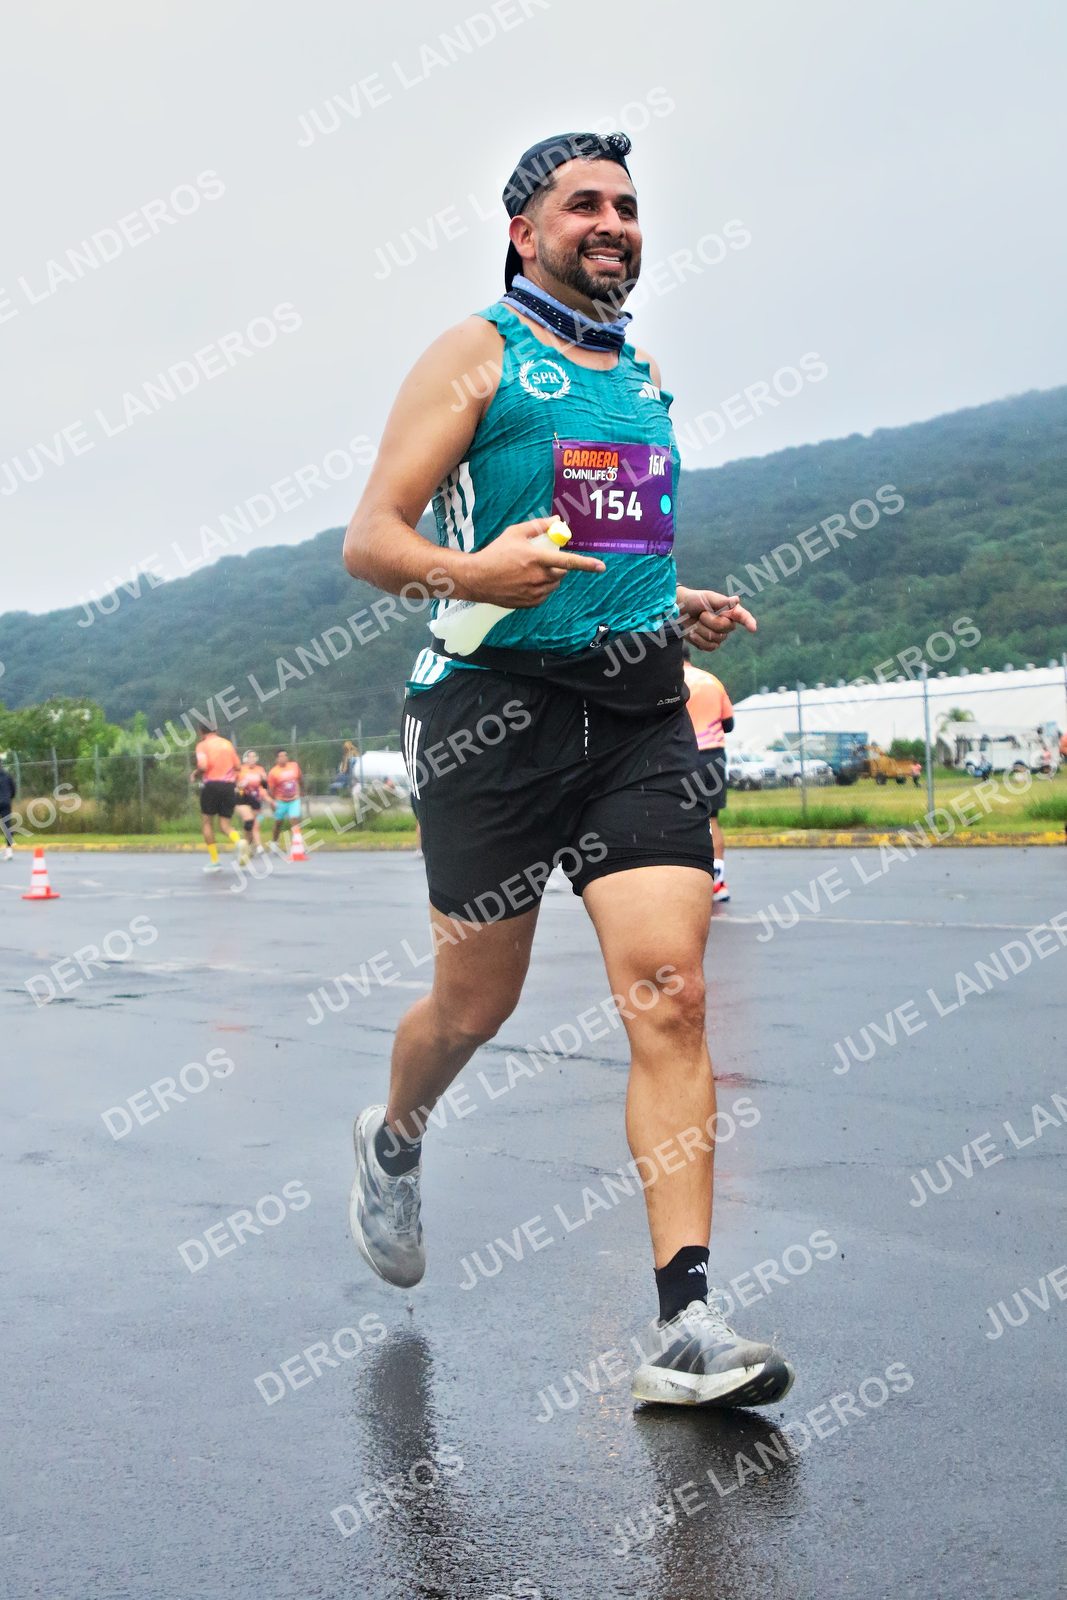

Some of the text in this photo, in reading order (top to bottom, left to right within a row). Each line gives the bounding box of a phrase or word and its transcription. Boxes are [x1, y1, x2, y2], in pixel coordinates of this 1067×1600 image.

[532, 372, 561, 385] SPR
[563, 449, 618, 468] CARRERA
[648, 454, 666, 476] 15K
[563, 468, 606, 481] OMNILIFE
[589, 489, 643, 522] 154
